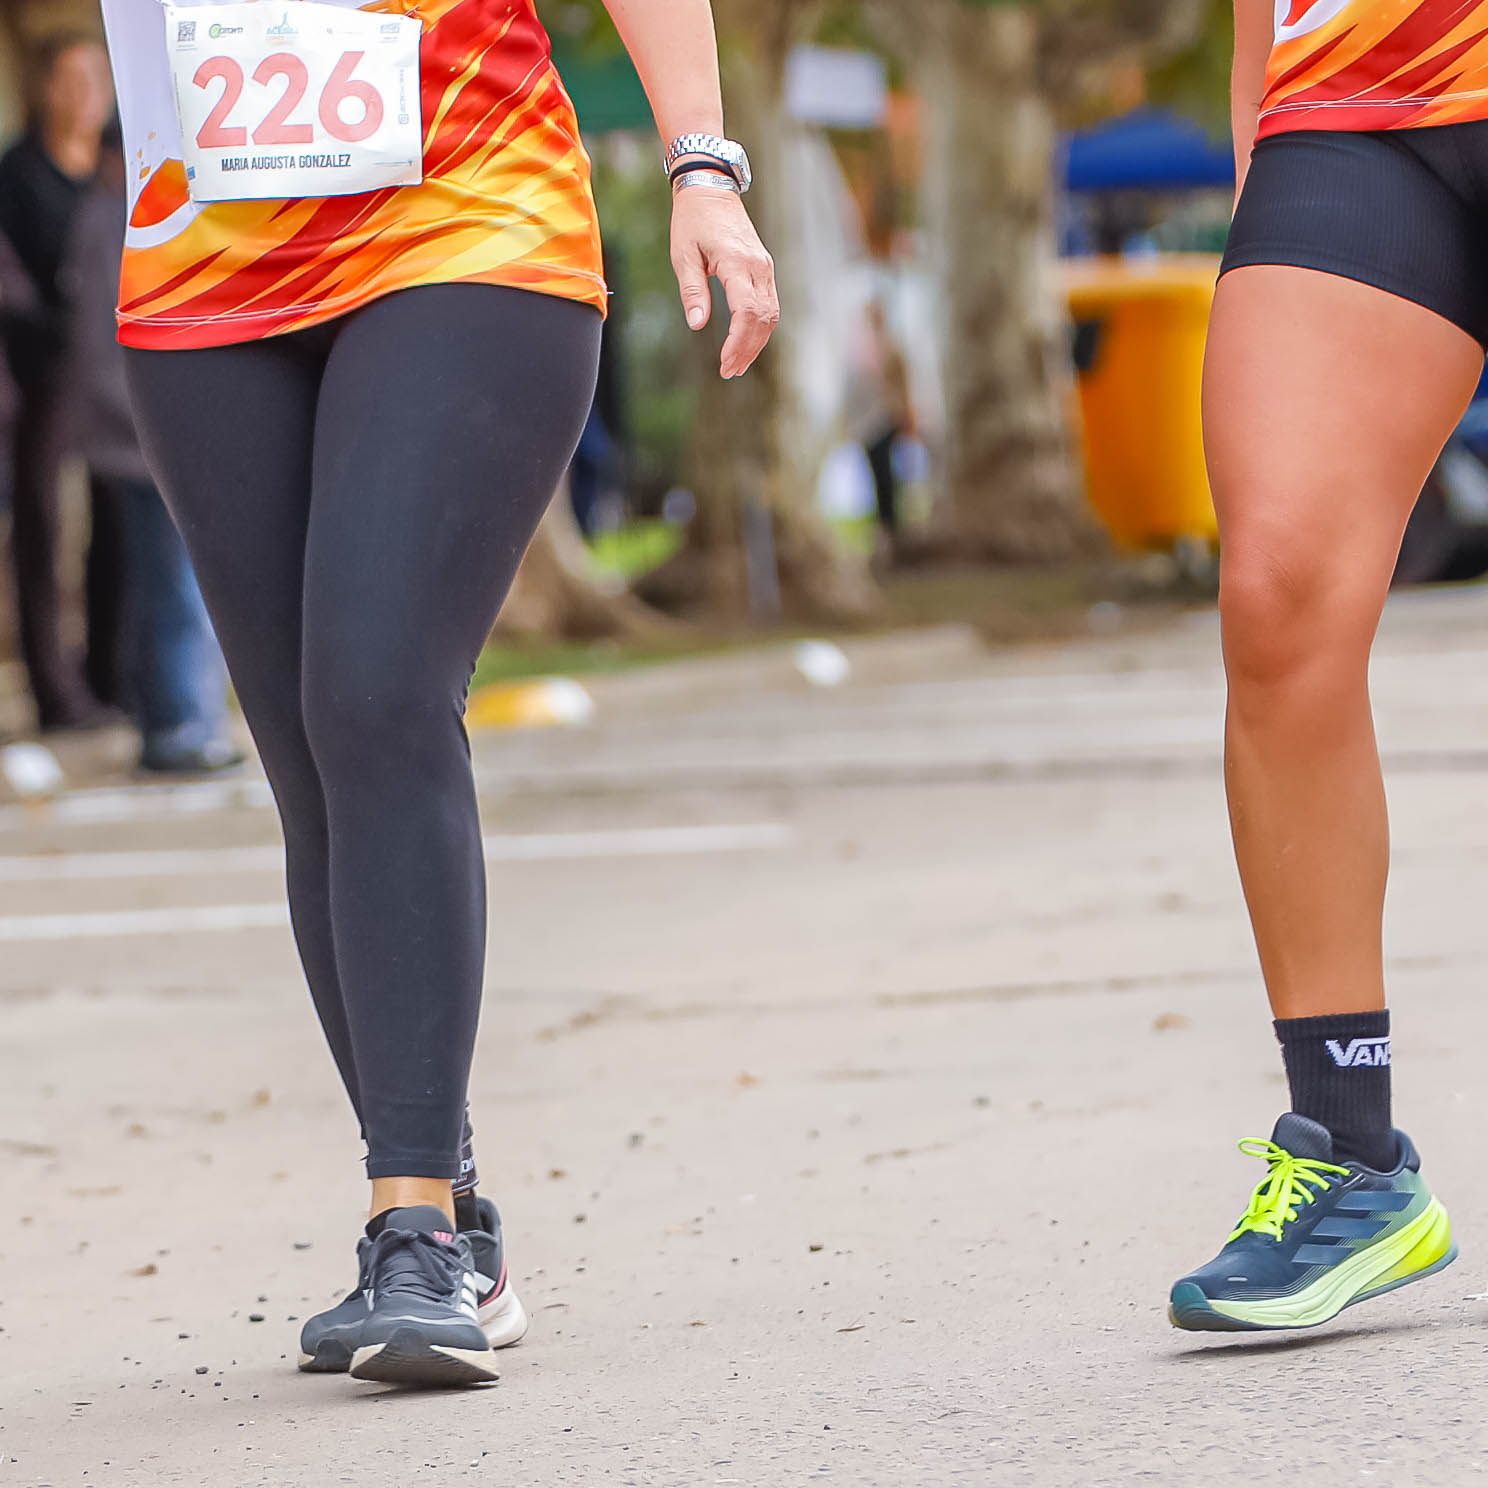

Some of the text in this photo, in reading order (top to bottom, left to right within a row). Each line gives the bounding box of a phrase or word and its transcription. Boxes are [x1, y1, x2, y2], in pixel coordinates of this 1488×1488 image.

[192, 51, 385, 149] 226
[221, 153, 352, 172] MARIA AUGUSTA GONZALEZ
[1324, 1037, 1390, 1067] VAN
